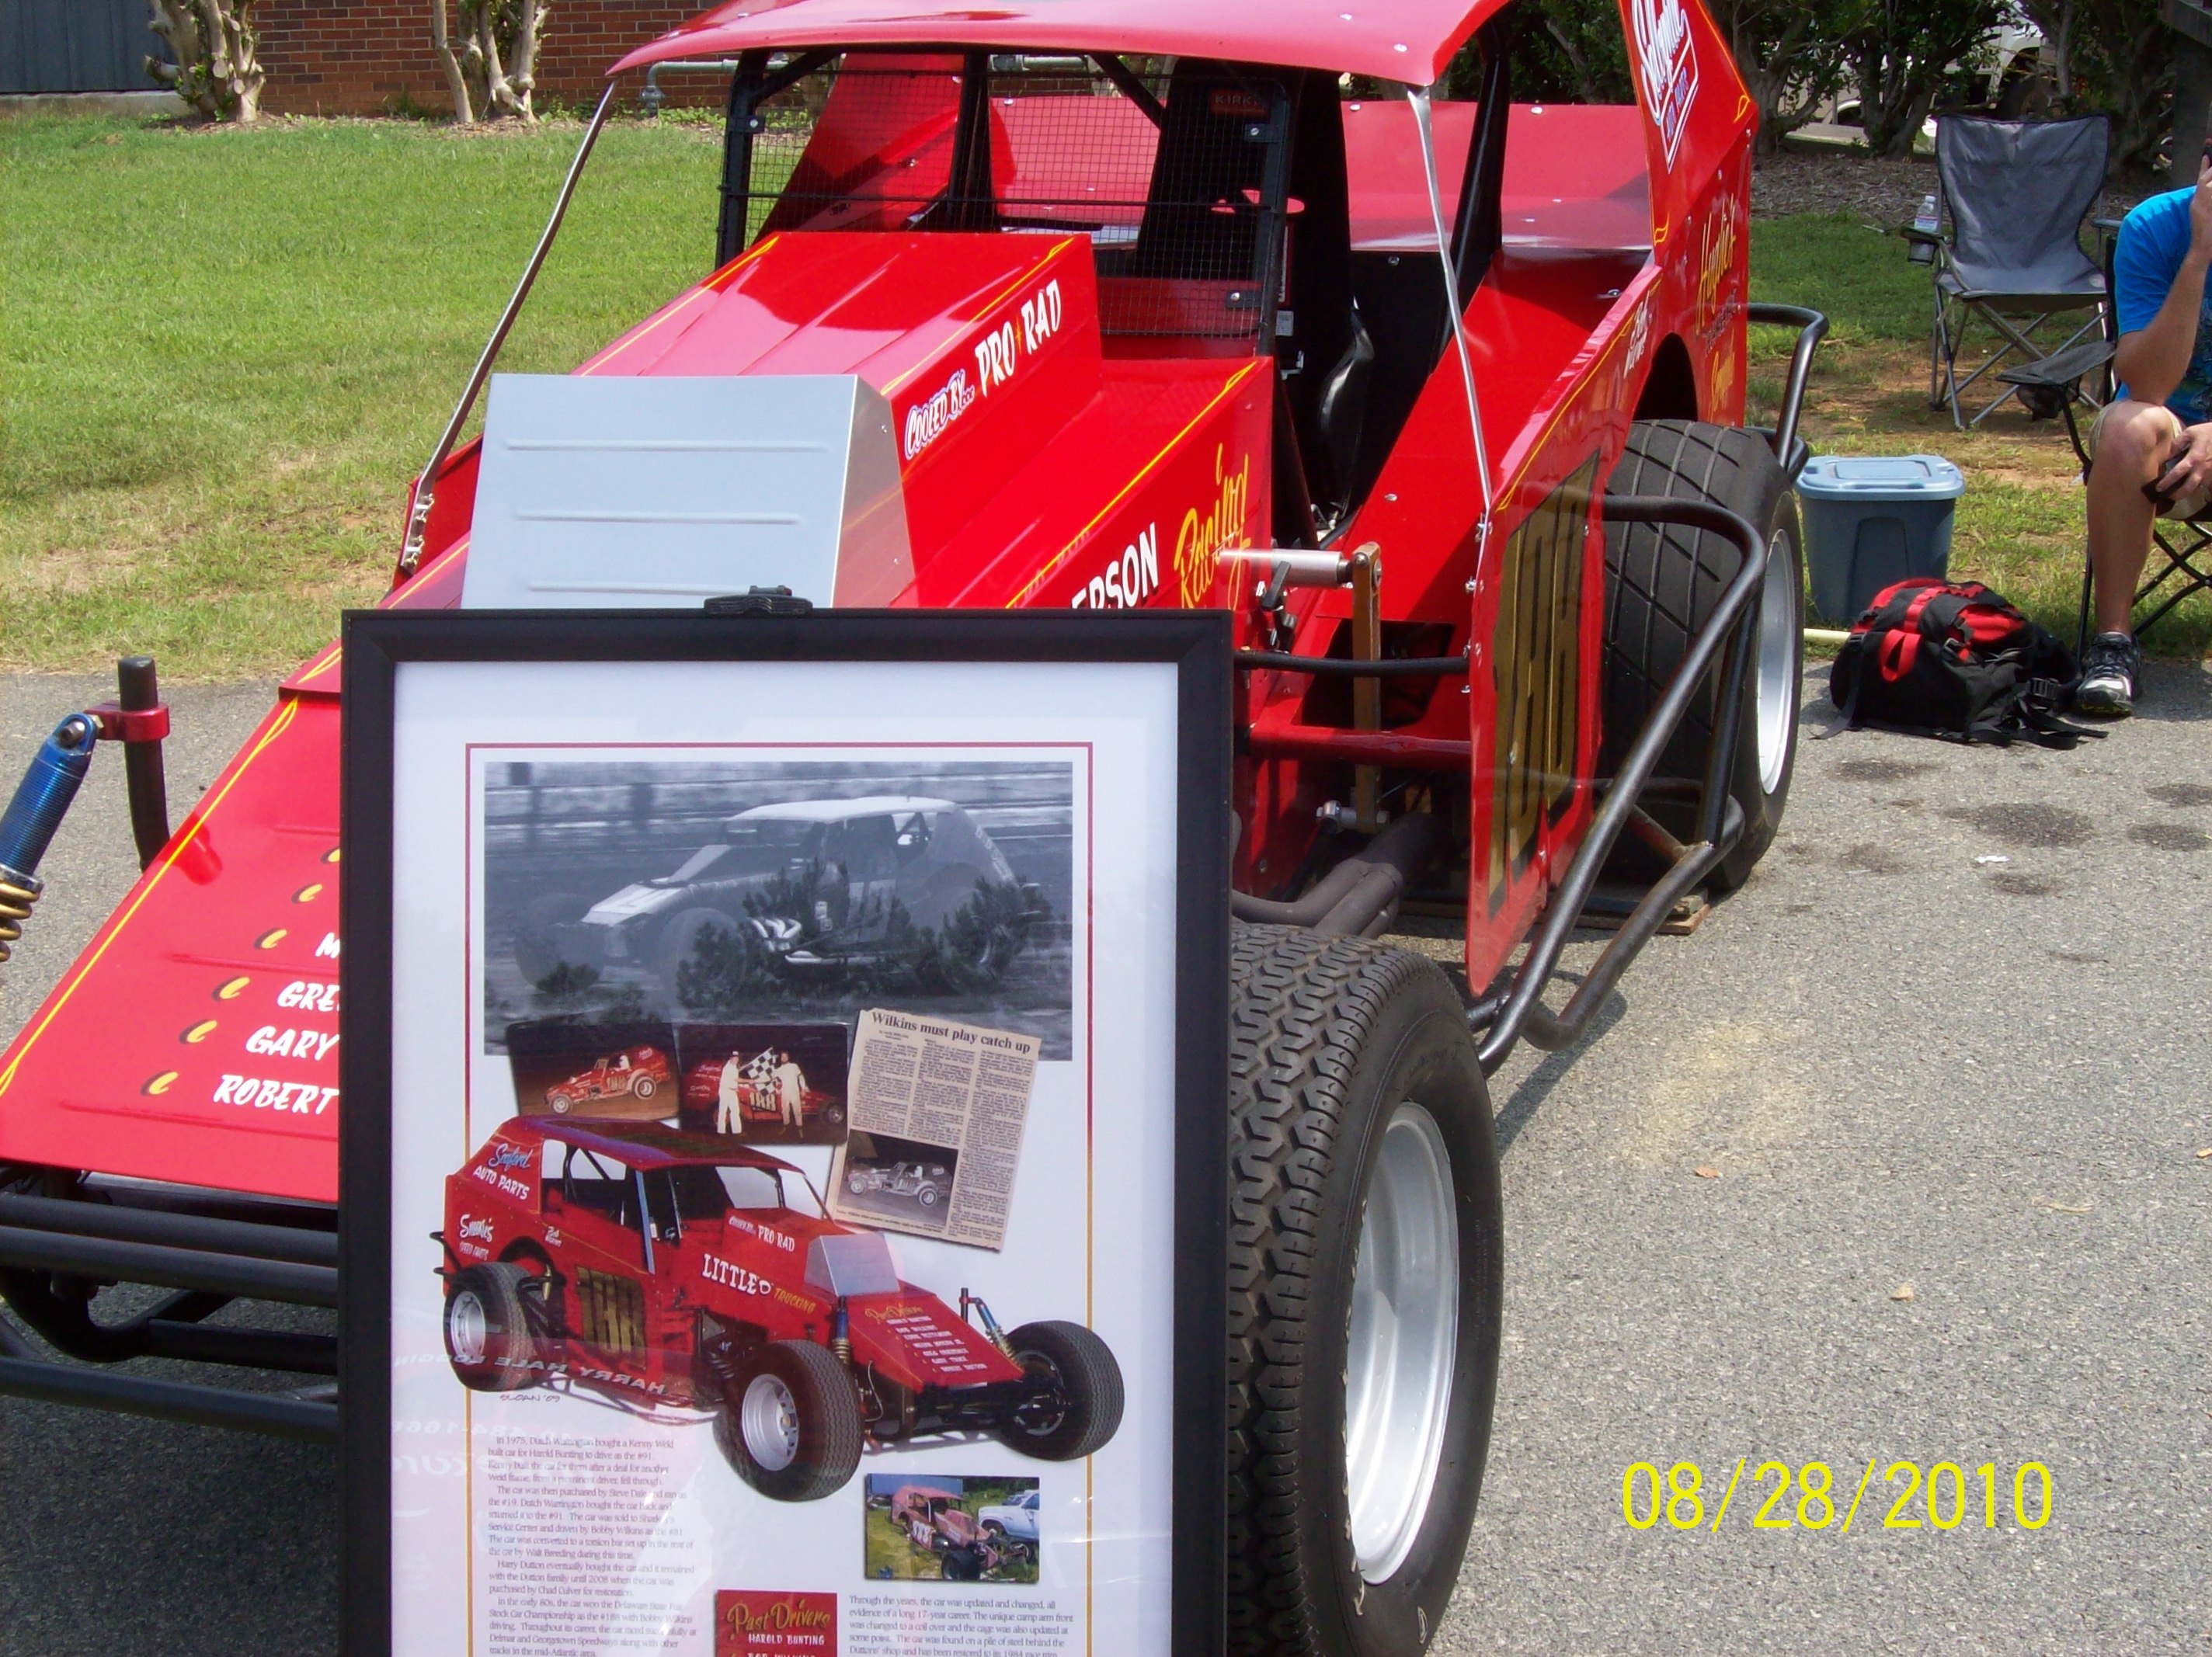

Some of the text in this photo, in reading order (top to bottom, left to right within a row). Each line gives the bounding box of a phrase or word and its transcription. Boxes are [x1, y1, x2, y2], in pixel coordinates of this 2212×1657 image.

[905, 390, 948, 460] COOLED
[976, 326, 1015, 397] PRO
[1021, 279, 1062, 356] RAD
[1174, 443, 1251, 611] Racing
[277, 981, 340, 1013] GRE
[871, 1011, 917, 1033] Wilkins
[920, 1021, 949, 1038] must
[952, 1027, 978, 1044] play
[980, 1034, 1013, 1051] catch
[1015, 1040, 1031, 1054] up
[245, 1026, 339, 1061] GARY
[213, 1074, 339, 1115] ROBERT
[473, 1165, 530, 1200] AUTO PARTS
[758, 1225, 774, 1244] PRO
[777, 1232, 795, 1252] RAD
[702, 1252, 758, 1295] LITTLE
[773, 1287, 816, 1315] TRUCKING
[595, 1438, 621, 1449] bought
[629, 1439, 652, 1450] Kenny
[555, 1450, 583, 1461] Bunting
[489, 1547, 500, 1556] the
[514, 1548, 523, 1558] by
[578, 1551, 600, 1559] during
[497, 1560, 518, 1570] Harry
[586, 1563, 610, 1572] bought
[633, 1576, 645, 1585] the
[527, 1586, 536, 1596] by
[538, 1586, 556, 1594] Chad
[583, 1587, 593, 1596] for
[849, 1596, 881, 1606] Through
[882, 1596, 894, 1604] the
[920, 1597, 931, 1606] the
[964, 1600, 993, 1609] updated
[727, 1600, 830, 1634] Past Drivers
[899, 1609, 915, 1620] long
[989, 1614, 1014, 1623] unique
[1056, 1614, 1074, 1622] front
[963, 1624, 976, 1632] the
[1030, 1625, 1059, 1635] updated
[748, 1633, 825, 1646] HAROLD BUNTING
[941, 1635, 964, 1644] found
[998, 1637, 1006, 1645] of
[1025, 1638, 1051, 1647] behind
[1052, 1638, 1065, 1647] the
